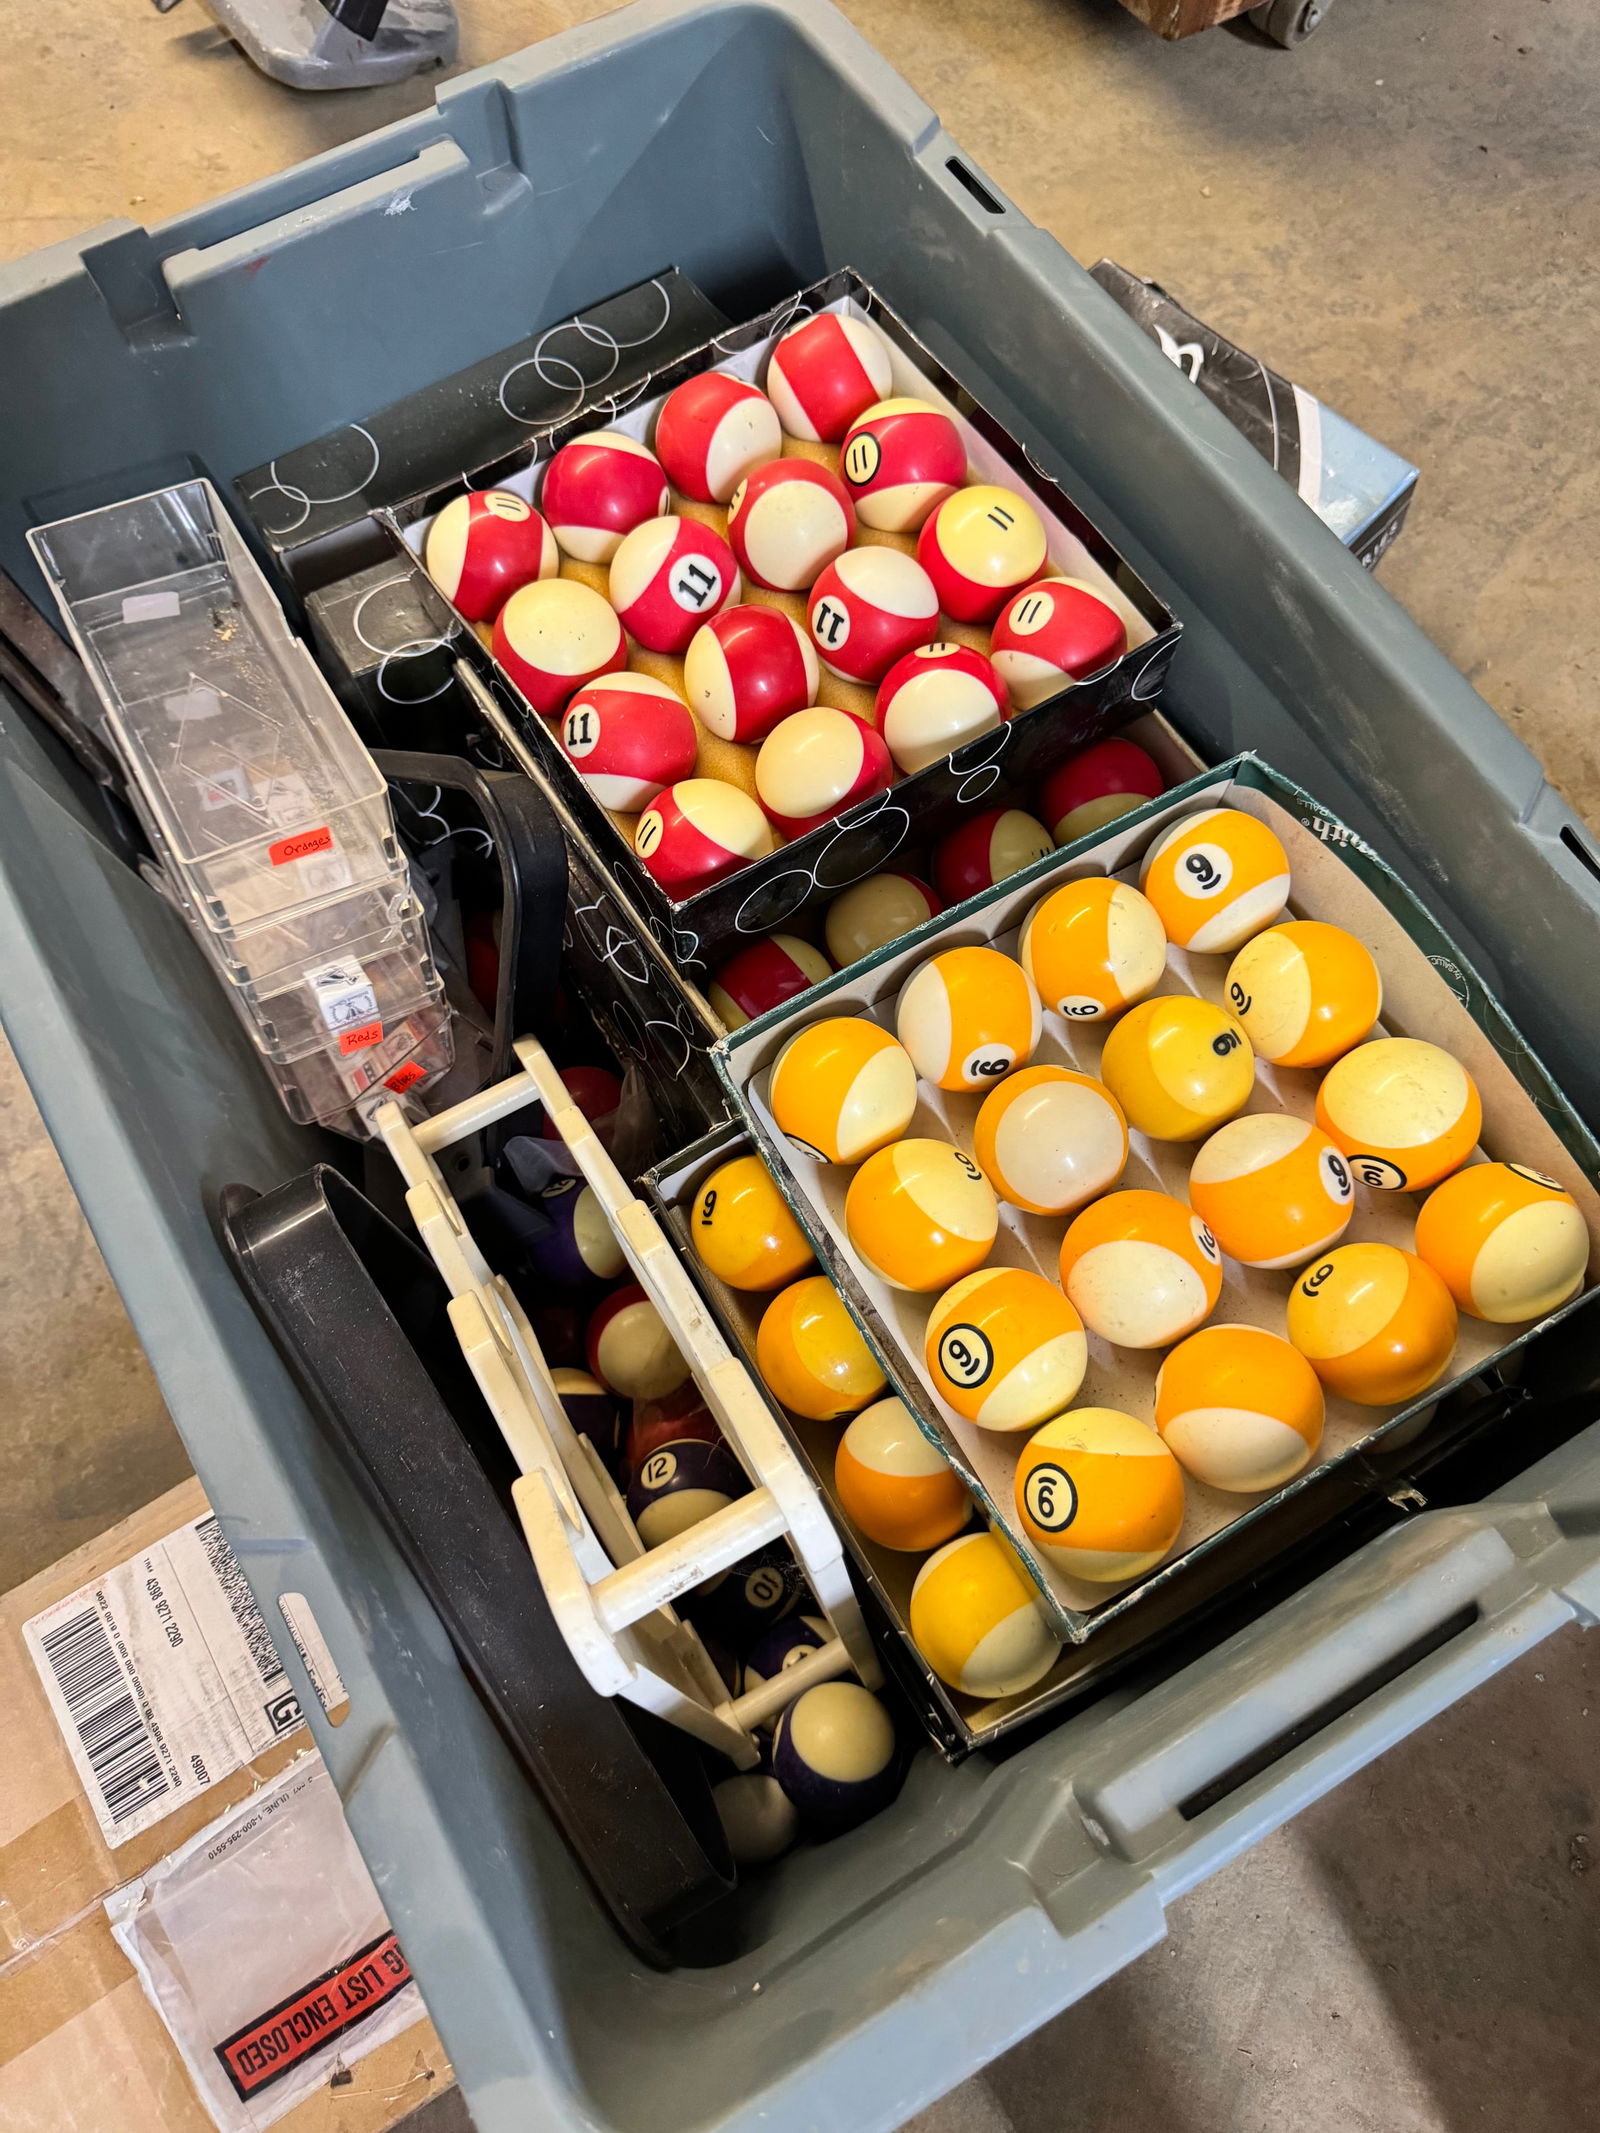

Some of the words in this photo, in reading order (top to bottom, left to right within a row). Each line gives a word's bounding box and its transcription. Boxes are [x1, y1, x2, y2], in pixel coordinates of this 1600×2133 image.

[853, 445, 867, 474] 11
[495, 497, 521, 512] 11
[987, 506, 1015, 531] 11
[679, 563, 717, 608] 11
[816, 602, 845, 644] 11
[1018, 599, 1042, 624] 11
[568, 712, 593, 746] 11
[284, 836, 331, 856] Oranges
[638, 818, 657, 849] 11
[1186, 854, 1221, 890] 9
[1063, 1004, 1099, 1016] 9
[1230, 982, 1252, 1016] 9
[346, 1030, 378, 1046] Reds
[1212, 1028, 1242, 1056] 9
[971, 1058, 1009, 1077] 9
[954, 1152, 982, 1180] 9
[1328, 1154, 1351, 1196] 9
[1361, 1164, 1384, 1186] 9
[701, 1190, 717, 1226] 9
[1302, 1264, 1334, 1297] 9
[949, 1339, 980, 1376] 9
[648, 1457, 668, 1483] 12
[1038, 1476, 1057, 1519] 9
[753, 1574, 779, 1601] 10
[145, 1578, 163, 1601] 4398
[155, 1599, 174, 1624] 9271
[165, 1622, 184, 1648] 2290
[190, 1754, 211, 1786] 49007
[208, 1814, 263, 1860] 1-800-295-5510
[338, 1964, 384, 2011] LIST
[236, 1994, 339, 2077] ENCLOSED
